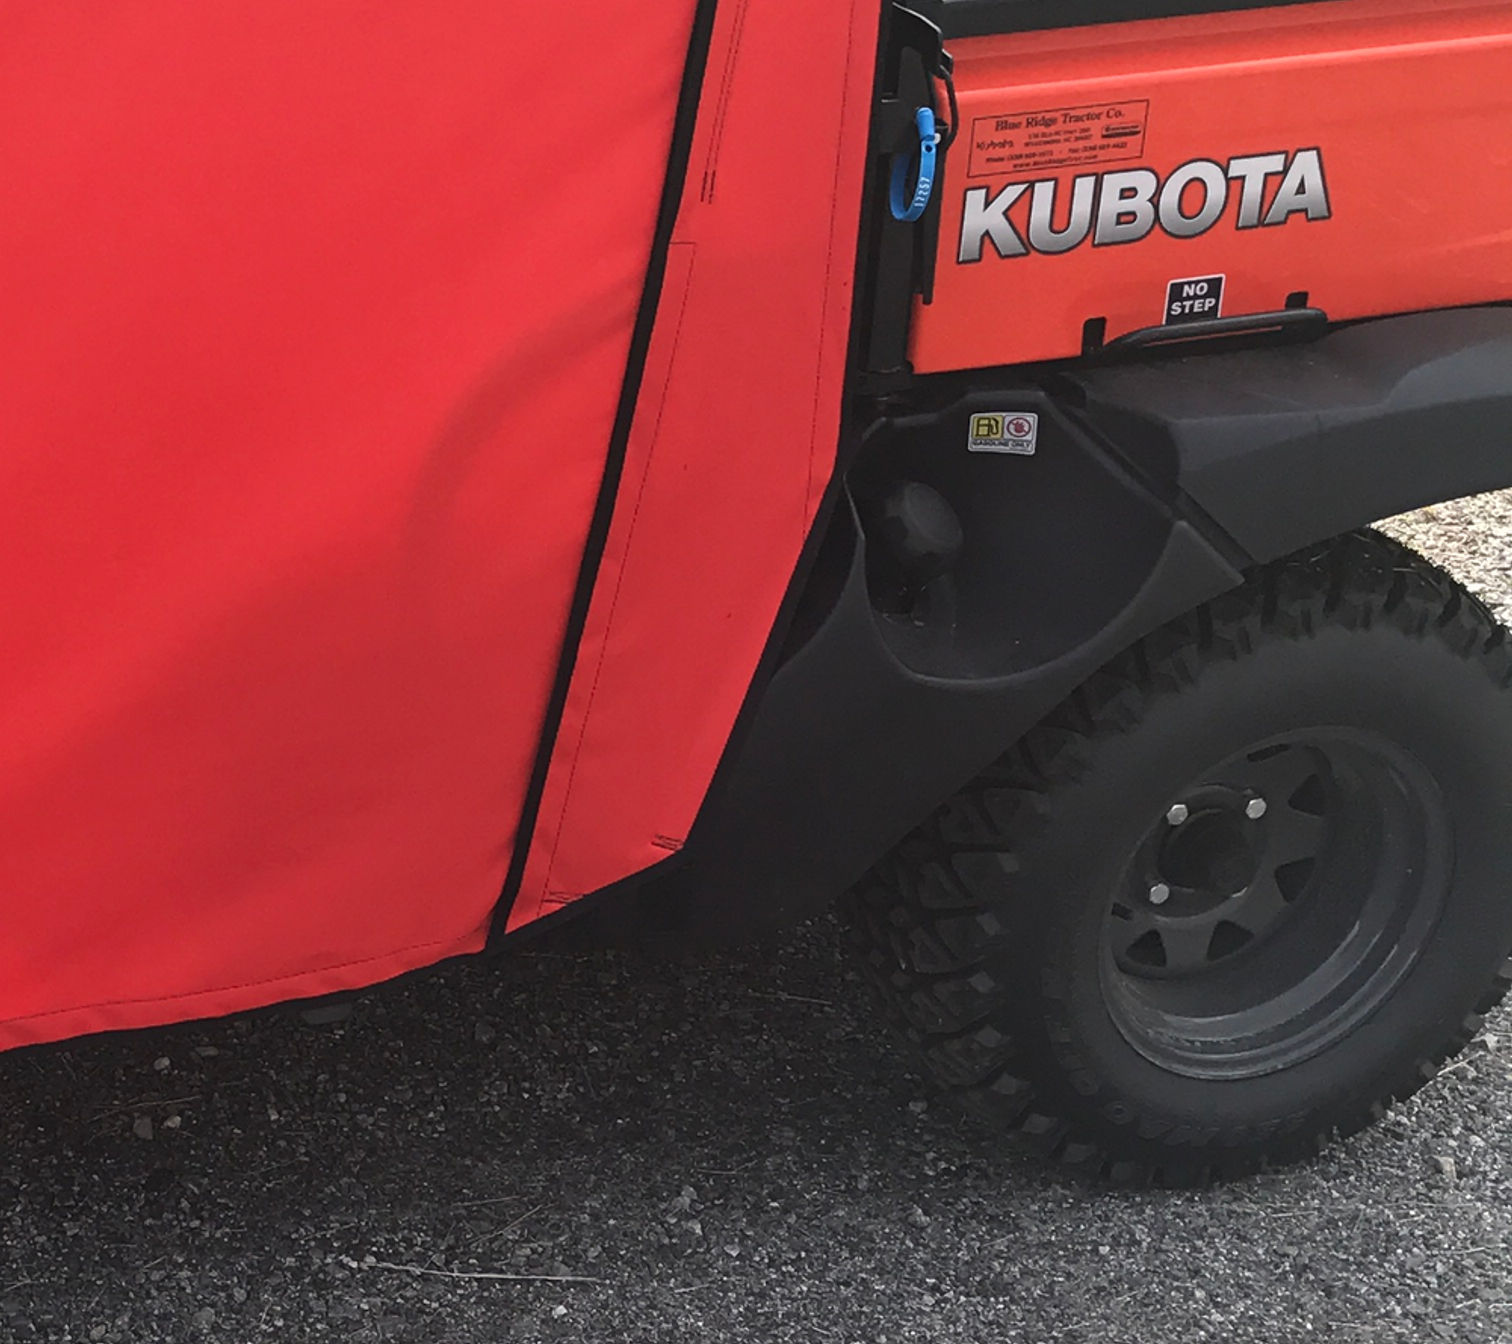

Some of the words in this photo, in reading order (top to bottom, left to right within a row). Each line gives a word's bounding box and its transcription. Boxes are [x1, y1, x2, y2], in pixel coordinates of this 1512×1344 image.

[995, 119, 1022, 132] Blue
[1026, 115, 1057, 129] Ridge
[1061, 111, 1102, 124] Tractor
[1106, 108, 1125, 119] Co.
[956, 147, 1331, 264] KUBOTA
[1182, 282, 1208, 297] NO
[1170, 298, 1216, 315] STEP
